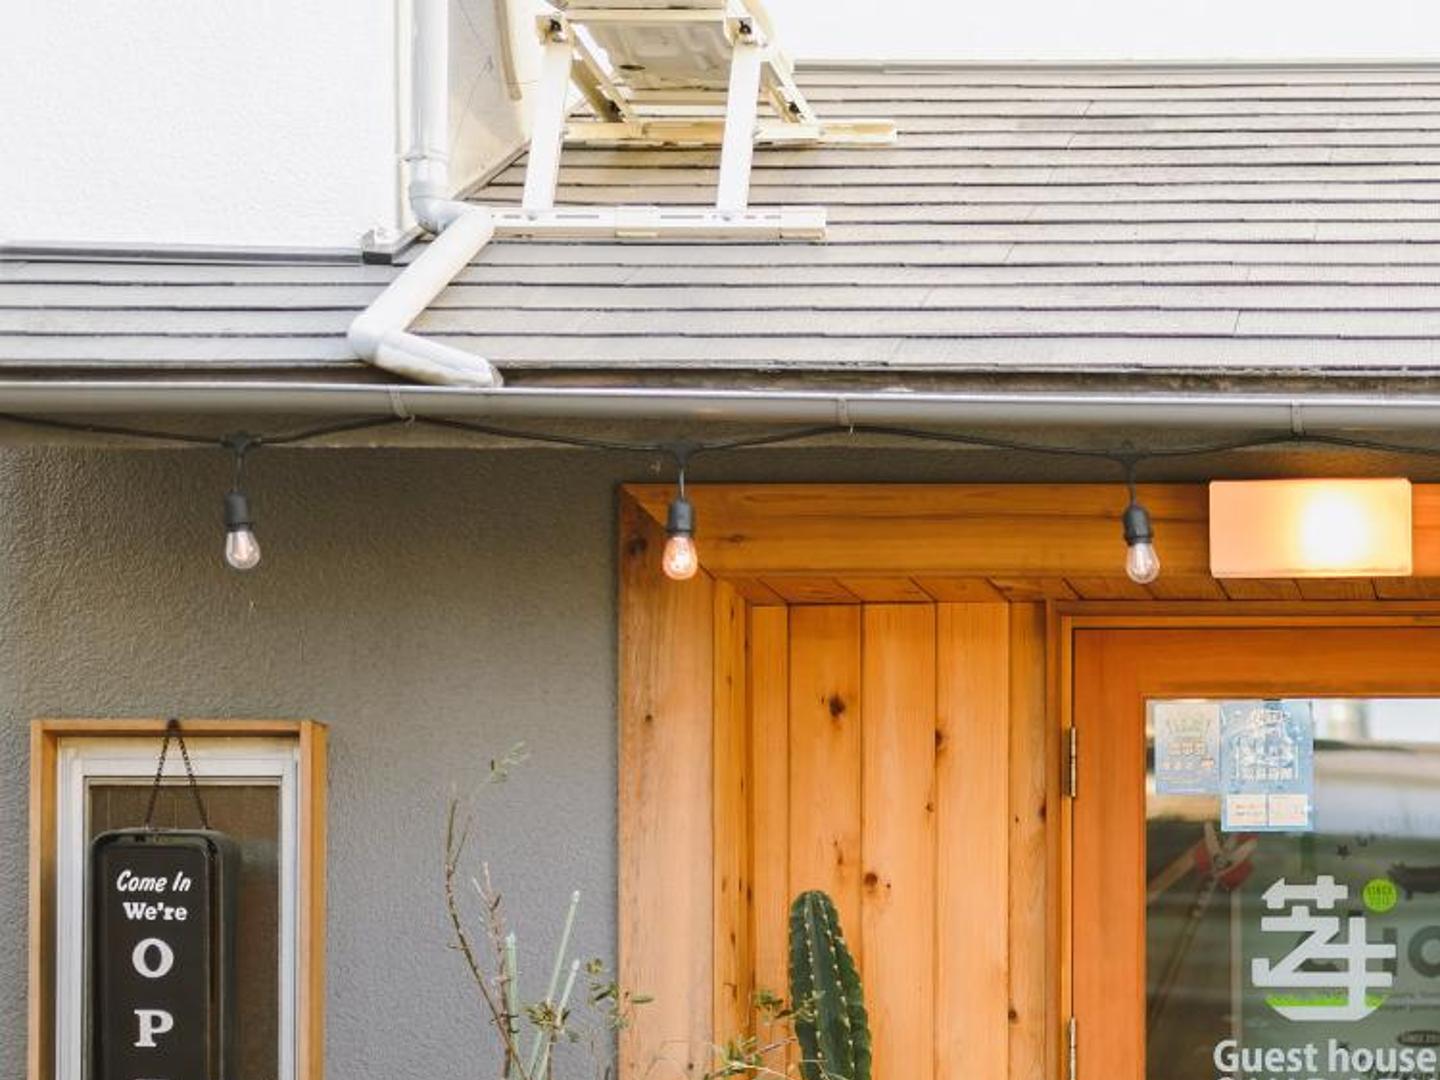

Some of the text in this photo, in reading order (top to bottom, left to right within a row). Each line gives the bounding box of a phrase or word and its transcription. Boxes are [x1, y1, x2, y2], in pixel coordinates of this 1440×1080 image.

[116, 869, 191, 892] Come In
[122, 902, 187, 920] We're
[1213, 1040, 1318, 1072] Guest
[1329, 1038, 1437, 1072] house
